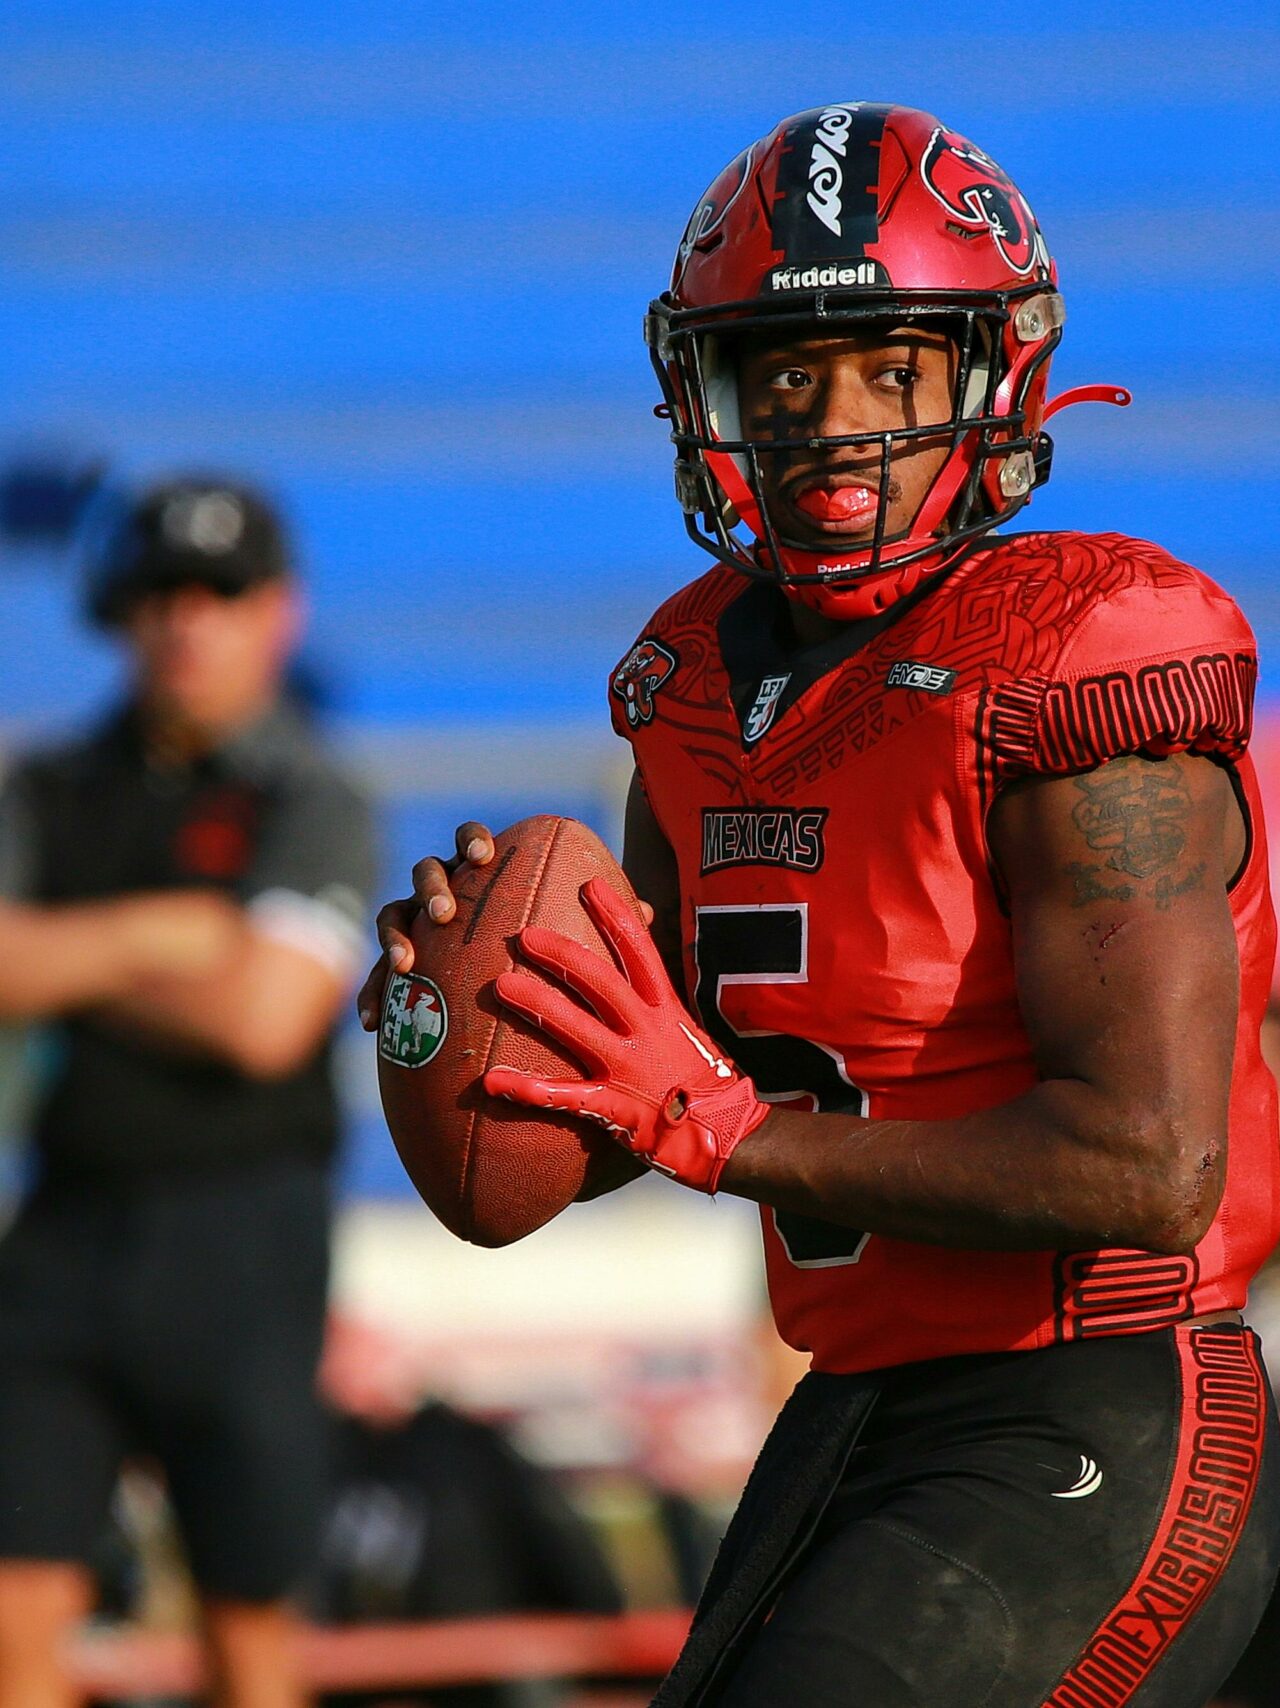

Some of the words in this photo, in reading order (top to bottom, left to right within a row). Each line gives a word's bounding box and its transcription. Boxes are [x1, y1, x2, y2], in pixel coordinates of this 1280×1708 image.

[772, 263, 876, 290] Riddell
[702, 813, 823, 869] MEXICAS
[695, 903, 870, 1268] 5
